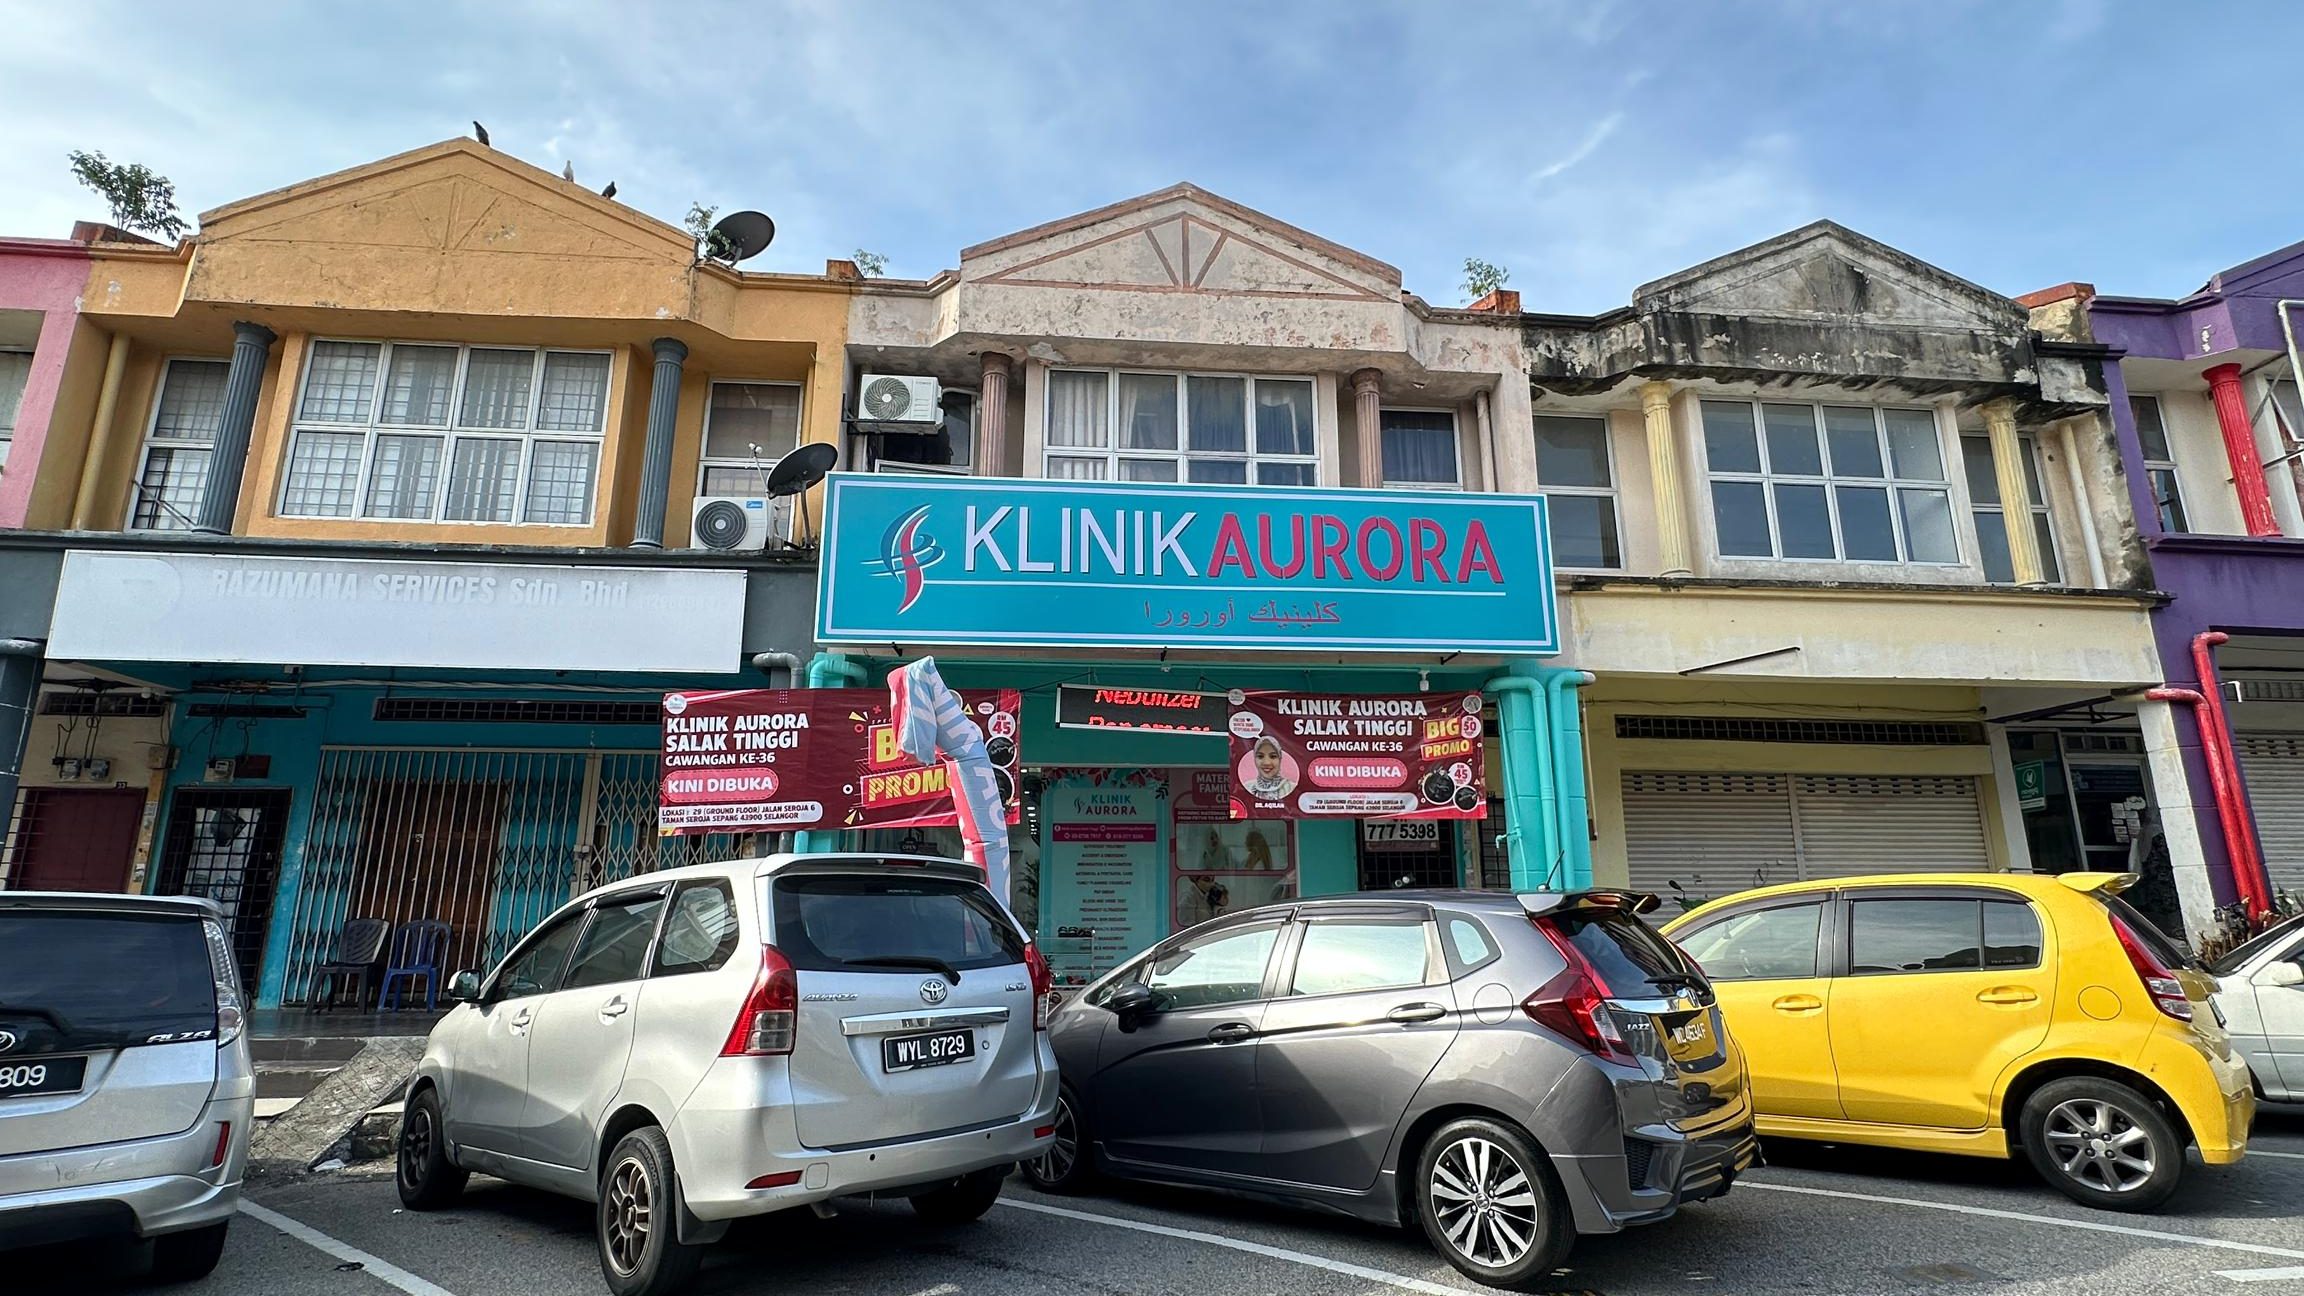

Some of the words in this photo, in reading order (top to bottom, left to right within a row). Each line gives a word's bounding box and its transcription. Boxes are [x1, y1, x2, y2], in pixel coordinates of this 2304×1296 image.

[964, 505, 1198, 577] KLINIK
[1206, 513, 1504, 584] AURORA
[212, 569, 358, 600] RAZUMANA
[372, 573, 497, 604] SERVICES
[1248, 600, 1340, 625] كلينيك
[1278, 698, 1343, 716] KLINIK
[1348, 699, 1428, 718] AURORA
[666, 716, 729, 734] KLINIK
[734, 713, 809, 731] AURORA
[992, 721, 1012, 735] 45
[1293, 718, 1350, 736] SALAK
[1354, 719, 1413, 737] TINGGI
[1426, 717, 1460, 740] BIG
[1464, 721, 1477, 732] 50
[666, 733, 727, 753] SALAK
[733, 731, 799, 751] TINGGI
[1306, 741, 1368, 752] CAWANGAN
[1371, 741, 1403, 753] KE-36
[1424, 739, 1470, 759] PROMO
[665, 754, 736, 767] CAWANGAN
[739, 752, 776, 765] KE-36
[1196, 773, 1230, 784] MATER
[1315, 766, 1345, 778] KINI
[1347, 766, 1402, 779] DIBUKA
[1454, 769, 1468, 780] 45
[668, 778, 706, 794] KINI
[708, 775, 774, 792] DIBUKA
[868, 767, 950, 803] PROM
[1091, 795, 1131, 804] KLINIK
[662, 816, 684, 824] TAMAN
[712, 814, 739, 822] SEPANG
[764, 812, 799, 820] SELANGOR
[1086, 806, 1137, 815] AURORA
[1366, 824, 1397, 840] 777
[1399, 823, 1437, 840] 5398
[1624, 1023, 1650, 1033] JAZZ
[897, 1040, 927, 1063] WYL
[930, 1035, 966, 1058] 8729
